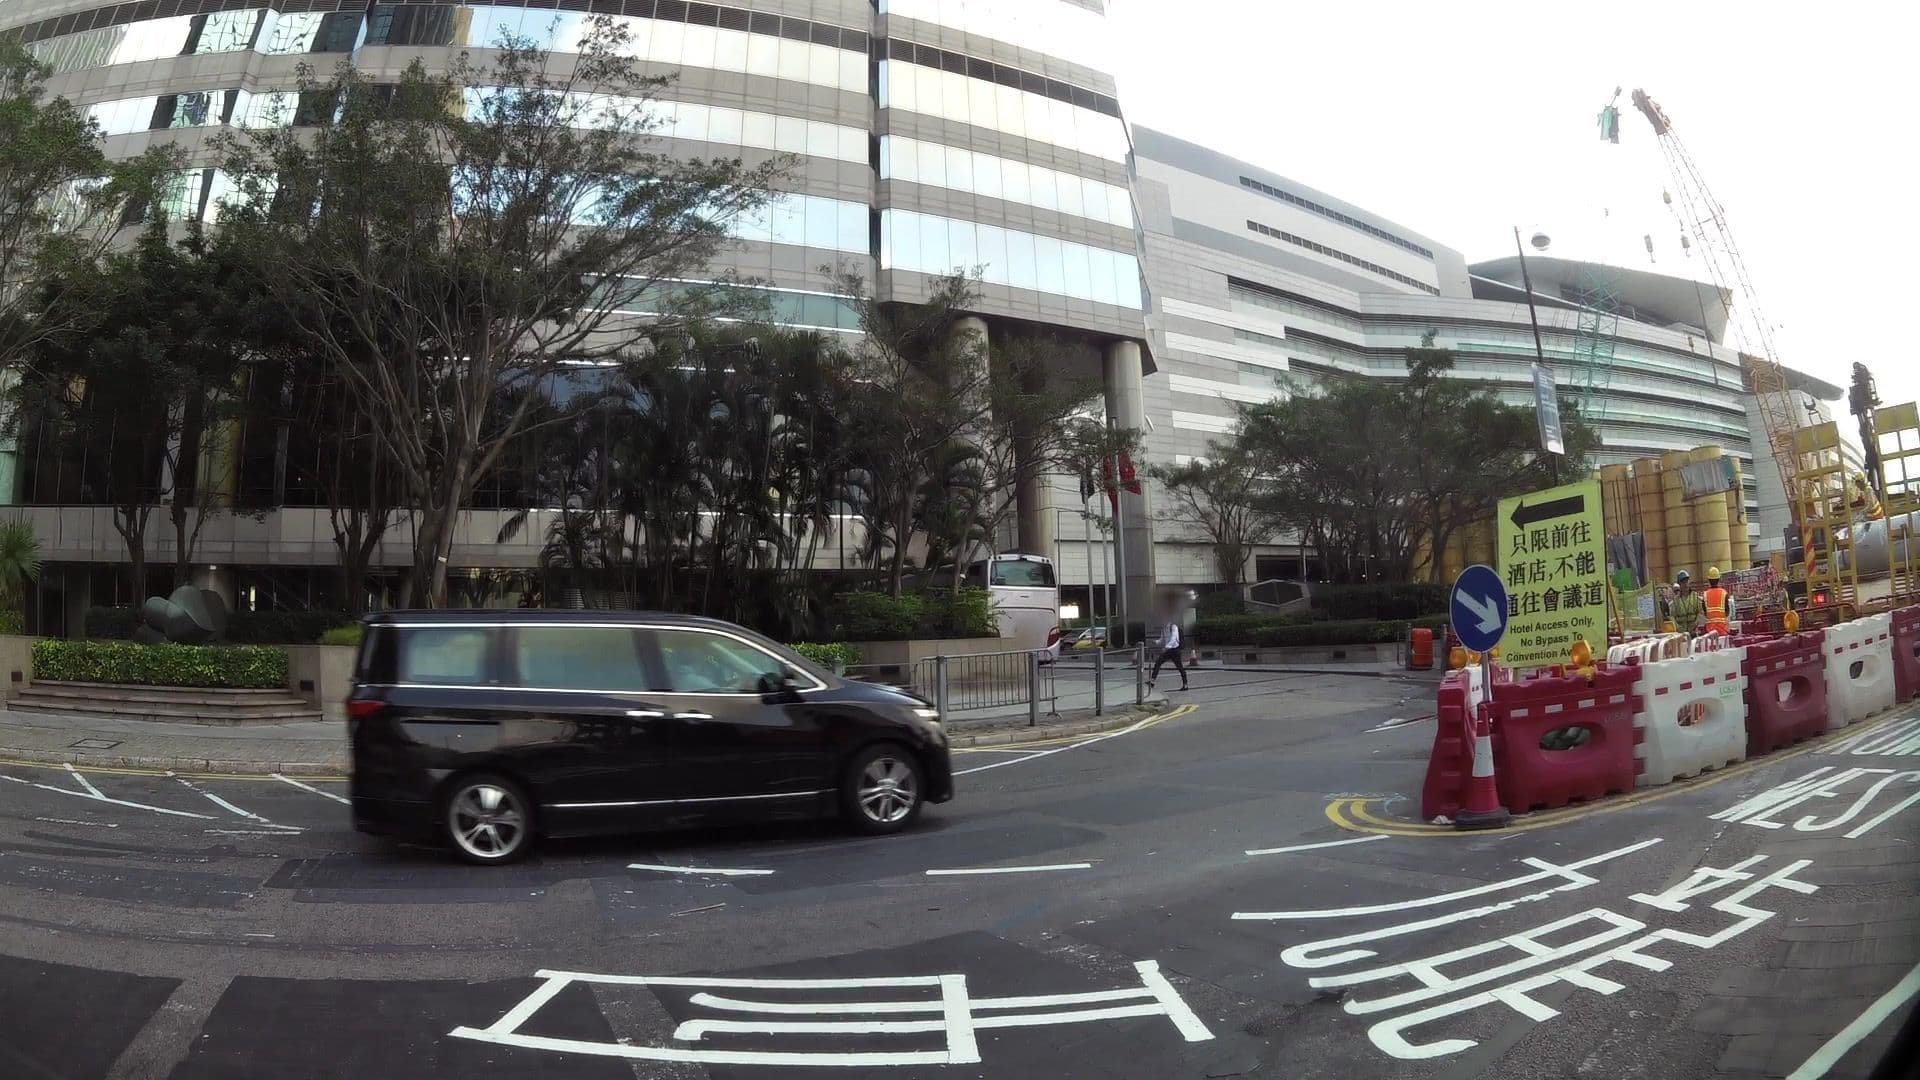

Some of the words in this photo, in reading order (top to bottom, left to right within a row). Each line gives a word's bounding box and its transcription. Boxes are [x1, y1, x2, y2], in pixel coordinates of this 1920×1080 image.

[1510, 521, 1592, 557] 只限前往
[1507, 581, 1604, 617] 通往會議道
[1510, 623, 1533, 635] Hotel
[1535, 619, 1569, 632] Access
[1520, 637, 1533, 648] No
[1536, 634, 1569, 648] Bypass
[1572, 631, 1583, 641] To
[1506, 646, 1558, 662] Convention
